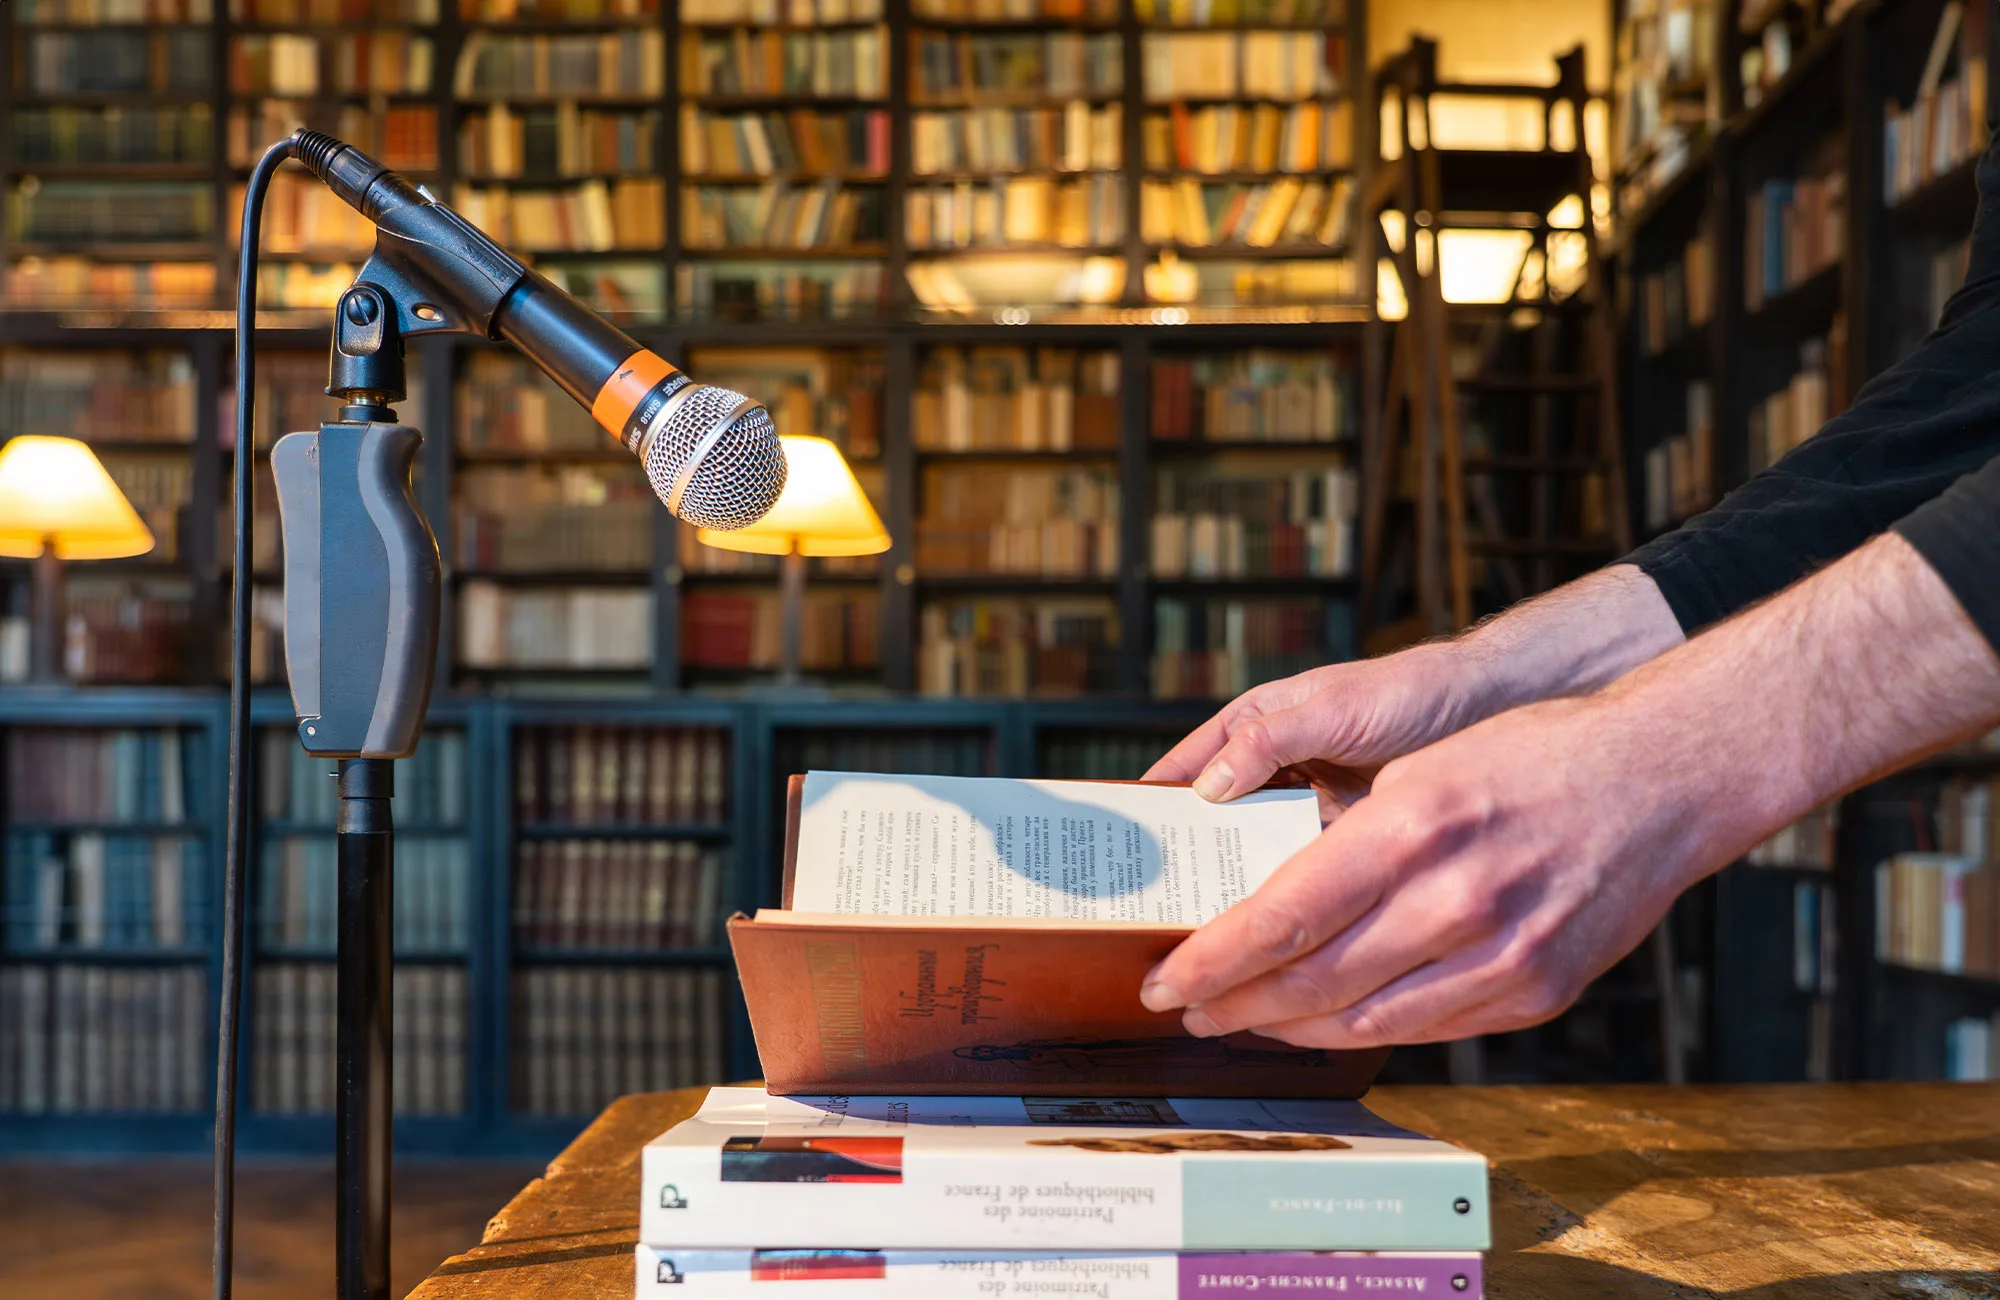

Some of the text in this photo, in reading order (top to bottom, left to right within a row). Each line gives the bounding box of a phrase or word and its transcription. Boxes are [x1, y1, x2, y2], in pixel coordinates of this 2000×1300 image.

[640, 399, 661, 425] SM58
[943, 1181, 1154, 1206] bibliothèques de France
[984, 1206, 1115, 1224] Patrimoine des
[938, 1256, 1150, 1280] bibliothèques de France
[978, 1281, 1110, 1299] Patrimoine des
[1355, 1275, 1426, 1291] ALSACE,
